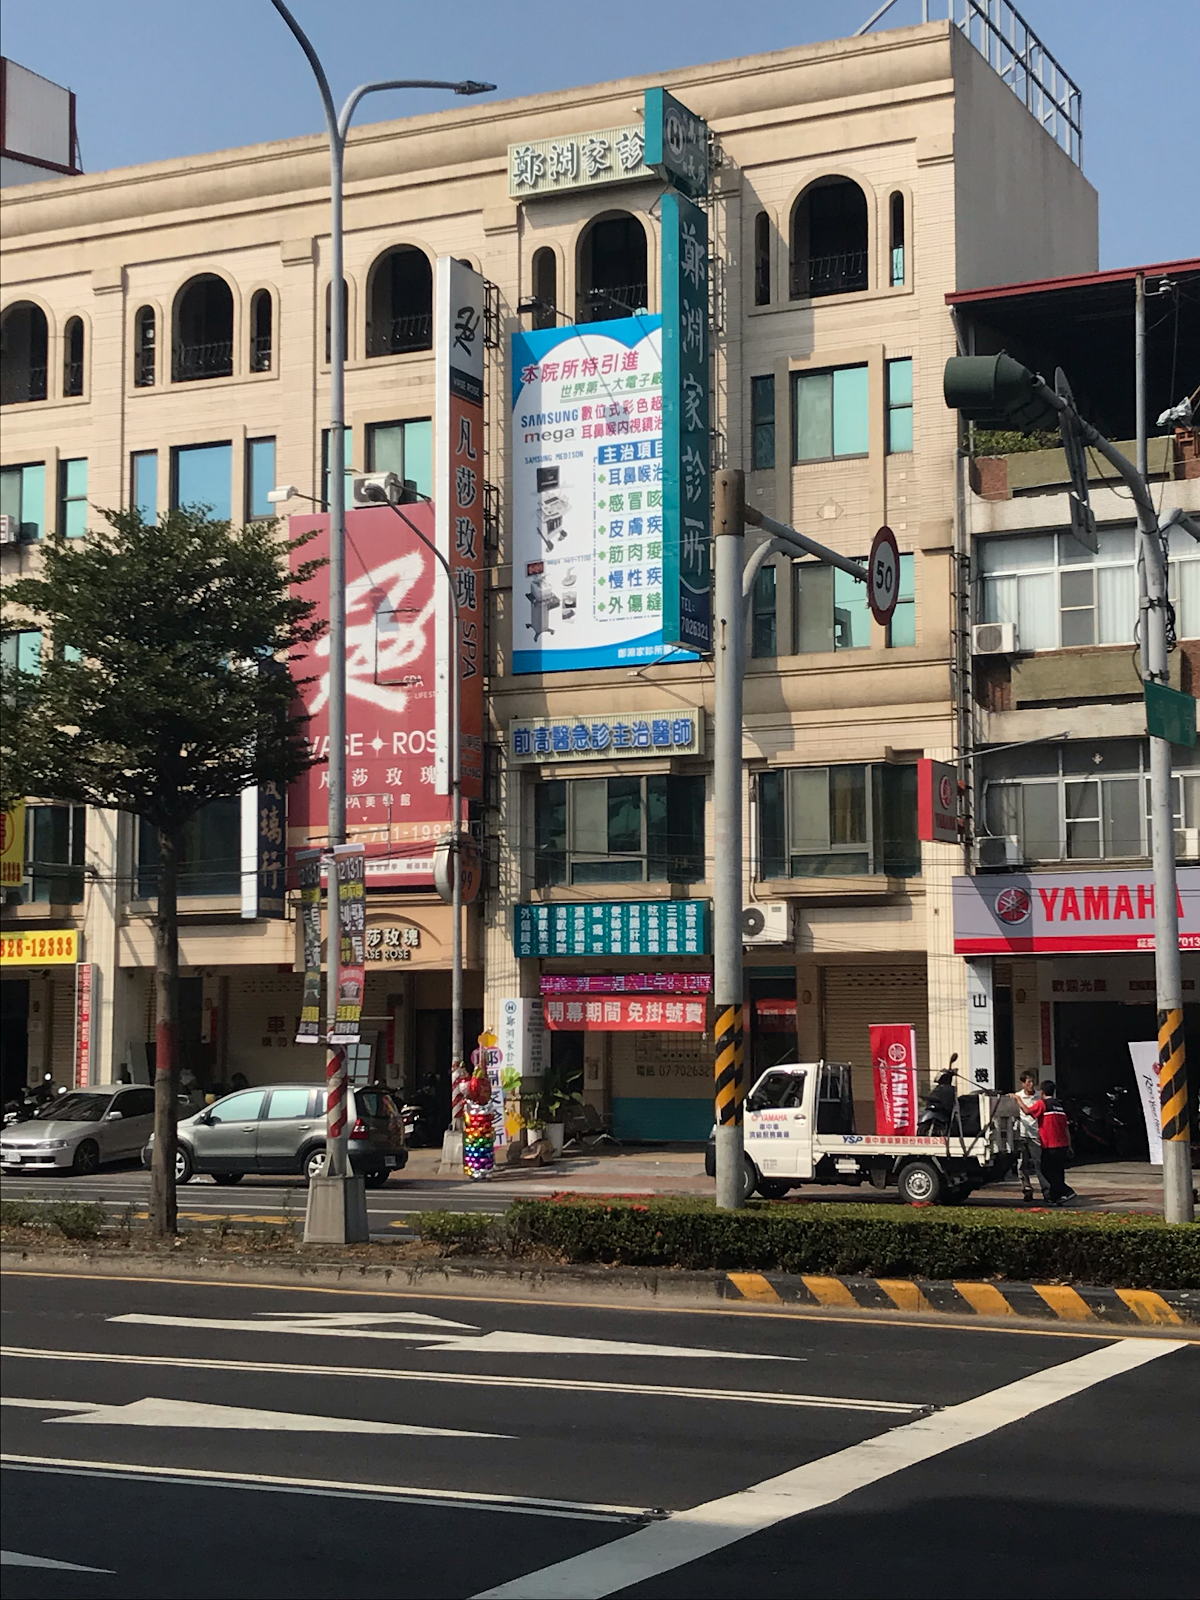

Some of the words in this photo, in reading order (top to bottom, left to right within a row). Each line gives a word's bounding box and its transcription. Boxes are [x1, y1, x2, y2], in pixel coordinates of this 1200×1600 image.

[513, 130, 645, 186] 鄭淵家診
[521, 351, 639, 384] 本院所特引進
[521, 408, 579, 428] SAMSUNG
[581, 396, 662, 421] 數位式彩色超
[524, 428, 575, 443] mega
[524, 454, 552, 464] SAMSUNG
[556, 450, 584, 461] MEDISON
[456, 415, 477, 610] 凡莎玫瑰
[608, 490, 662, 512] 感冒咳
[608, 515, 662, 538] 皮膚疾
[608, 566, 662, 589] 慢性疾
[875, 560, 893, 593] 50
[681, 617, 708, 643] 7026321
[462, 620, 477, 680] SPA
[392, 729, 436, 755] ROS
[513, 718, 693, 753] 前高醫急診主治醫師
[366, 928, 419, 946] 莎玫瑰
[365, 949, 381, 959] ASE
[384, 949, 409, 959] ROSE
[547, 1002, 621, 1023] 開幕期間
[627, 1002, 702, 1024] 免掛號費
[972, 993, 989, 1083] 山葉機
[890, 1062, 909, 1128] YAMAHA
[760, 1114, 788, 1122] YAMAHA
[843, 1135, 863, 1144] YSP
